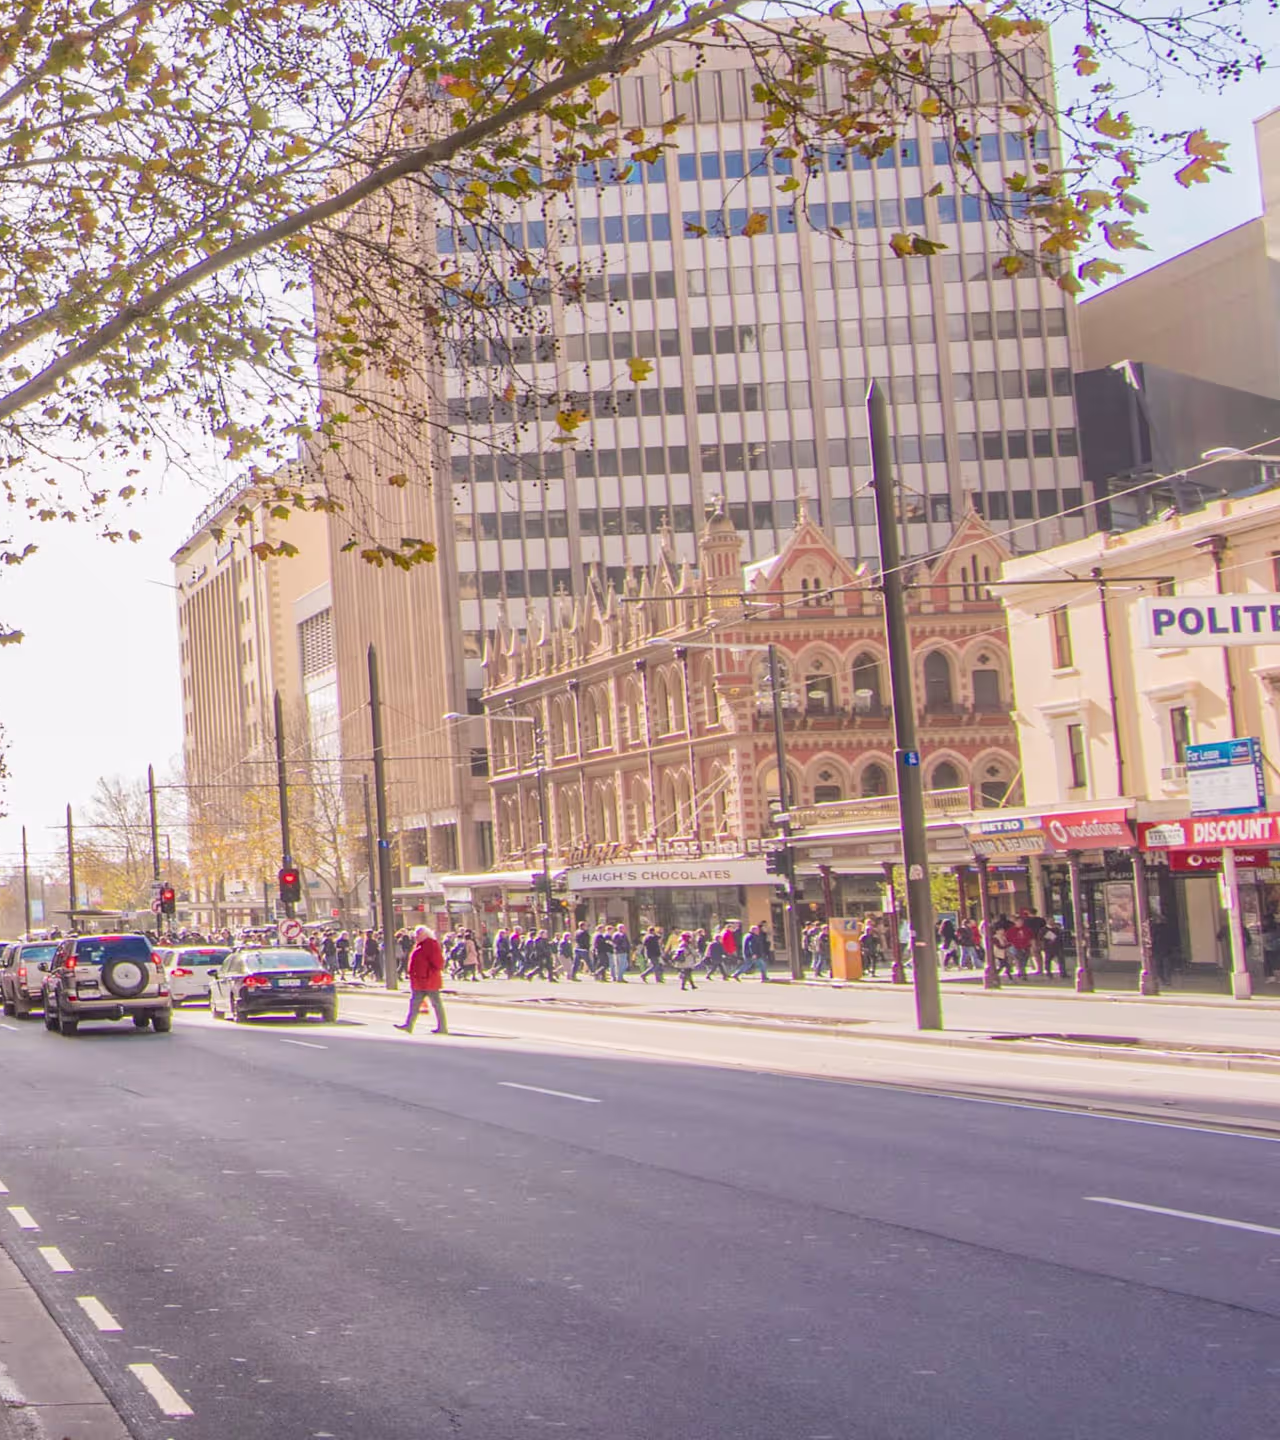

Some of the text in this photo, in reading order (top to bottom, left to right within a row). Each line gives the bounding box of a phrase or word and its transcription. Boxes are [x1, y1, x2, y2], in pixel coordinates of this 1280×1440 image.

[1067, 819, 1123, 838] vodafone
[1193, 817, 1273, 843] DISCOUNT
[1005, 836, 1045, 852] BEAUTY
[582, 869, 731, 883] HAIGH'S CHOCOLATES
